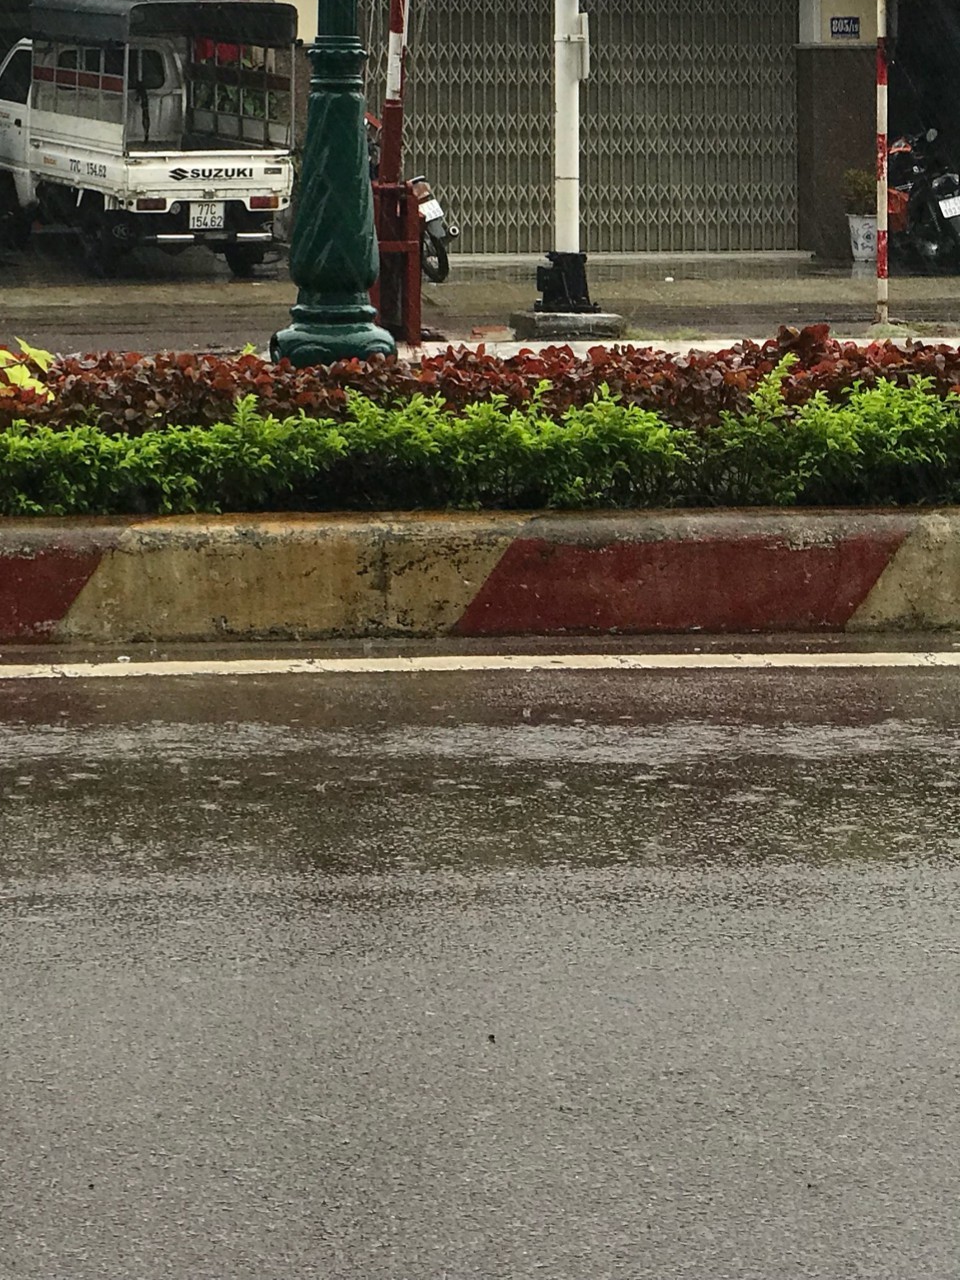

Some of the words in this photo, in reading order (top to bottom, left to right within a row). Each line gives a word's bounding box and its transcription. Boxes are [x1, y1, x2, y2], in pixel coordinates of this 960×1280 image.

[69, 158, 81, 173] 77C
[86, 161, 107, 179] 154.62
[190, 168, 254, 179] SUZUKI
[197, 203, 217, 217] 77C
[191, 215, 224, 229] 154.62
